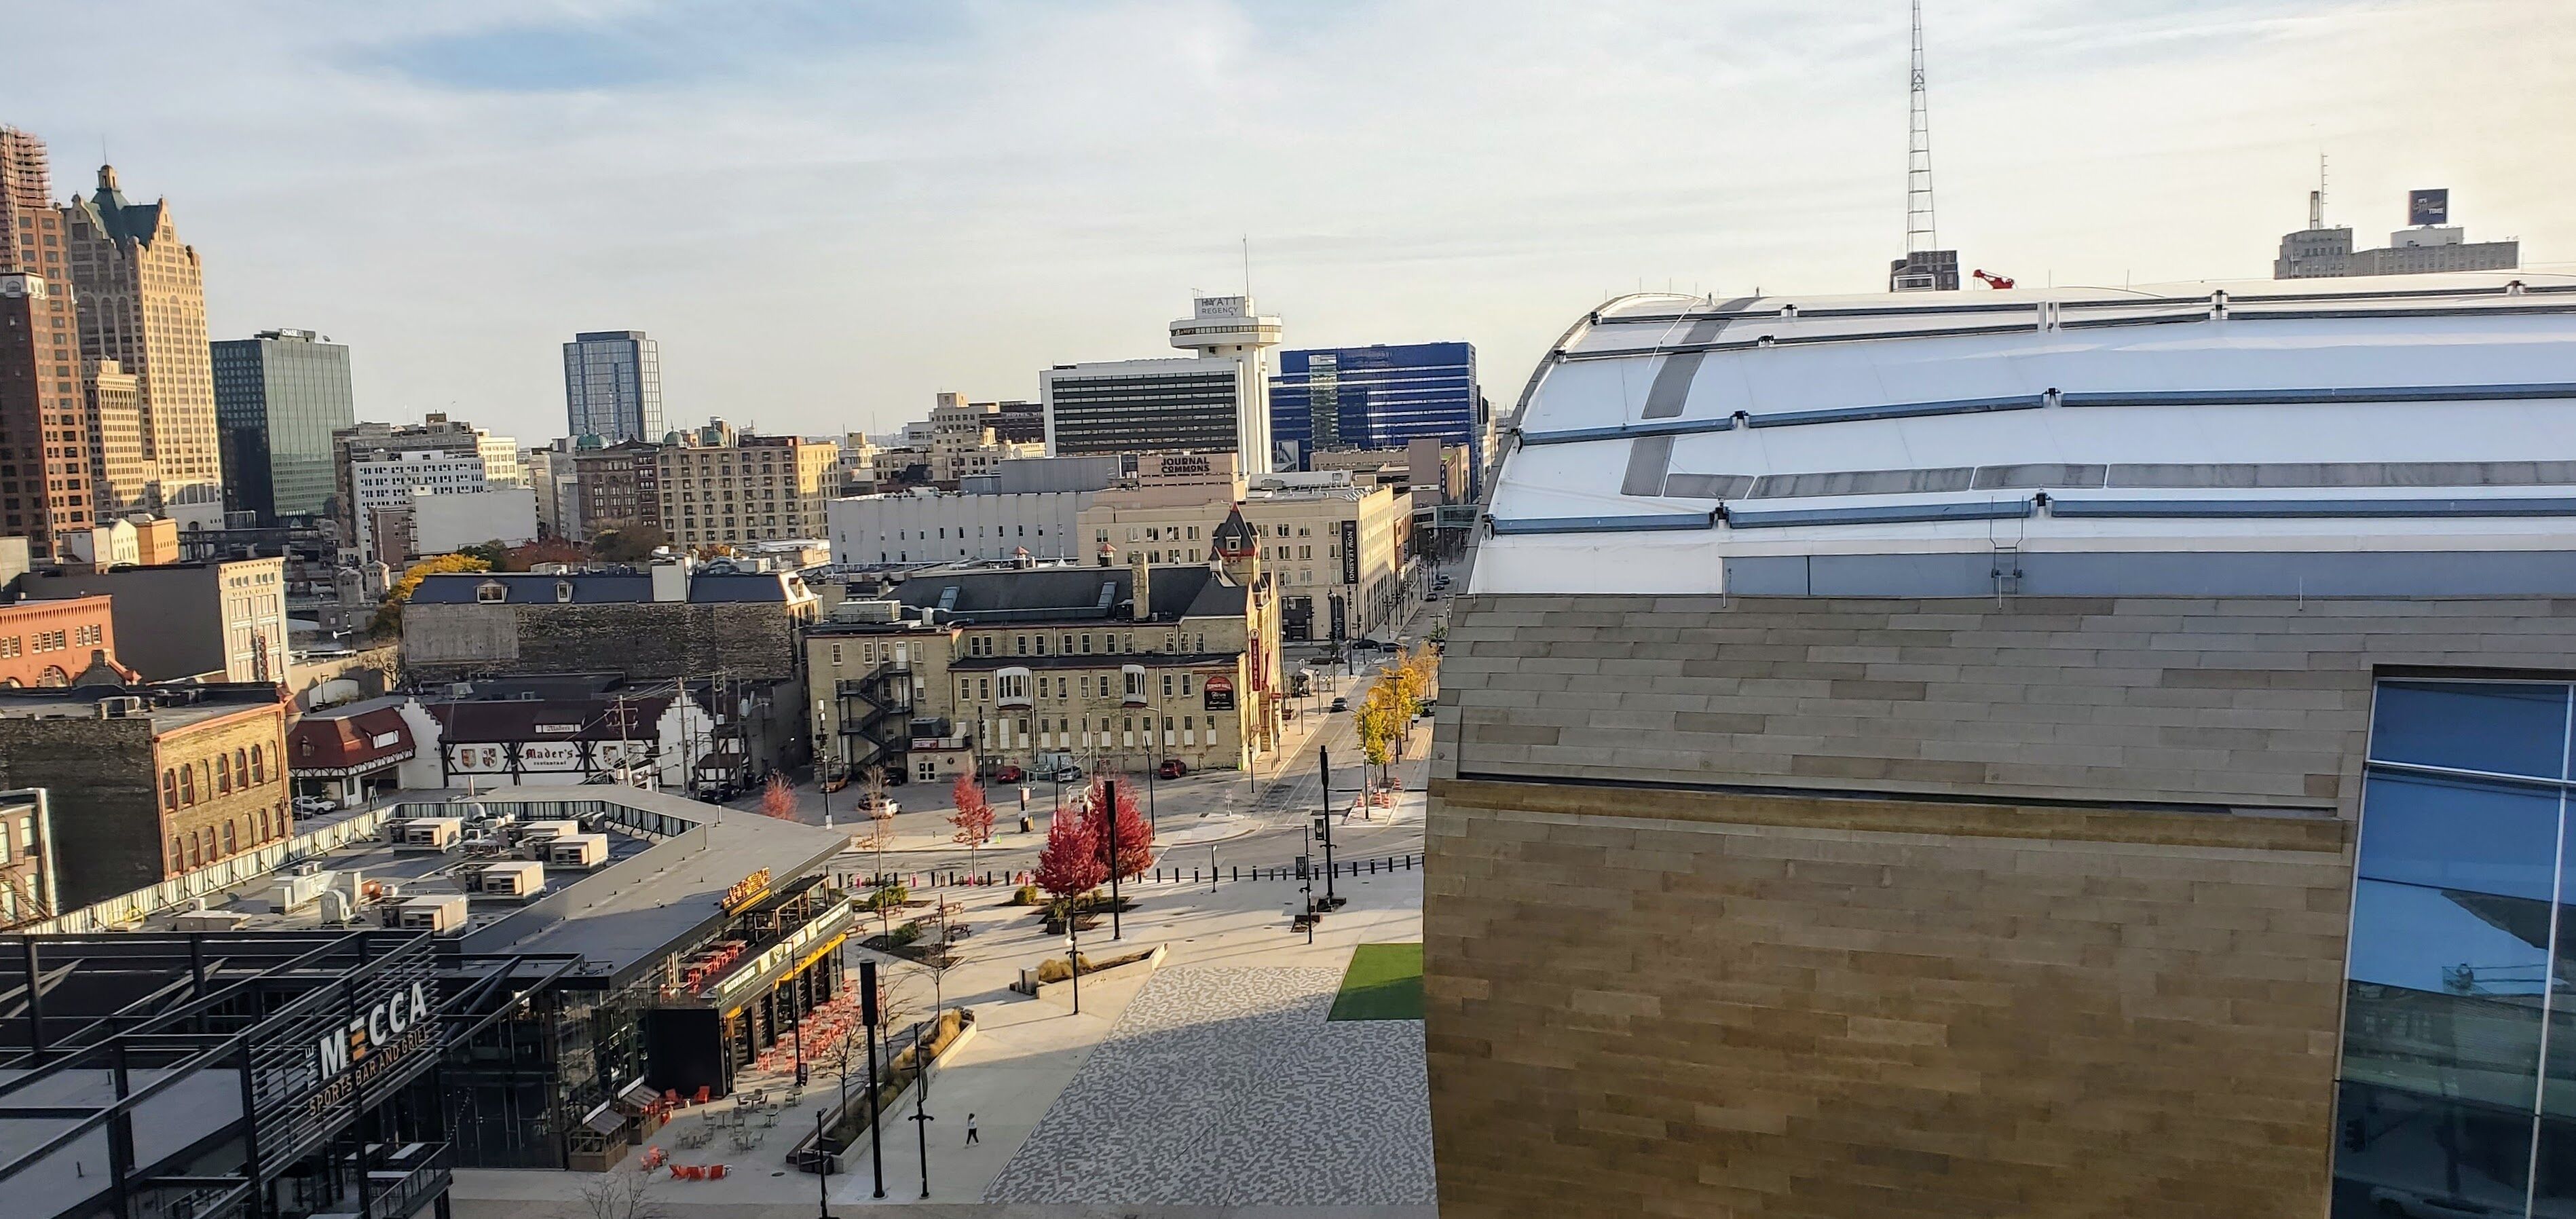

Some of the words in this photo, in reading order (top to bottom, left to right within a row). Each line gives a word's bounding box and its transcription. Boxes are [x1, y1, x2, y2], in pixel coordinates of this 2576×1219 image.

[1201, 298, 1237, 307] HYATT
[282, 329, 298, 337] CHASE
[1161, 457, 1210, 466] JOURNAL
[1161, 465, 1210, 473] COMMONS
[525, 747, 573, 759] Mader's
[320, 981, 427, 1081] MECCA
[305, 1045, 318, 1091] THE
[309, 1074, 352, 1117] SPORTS
[356, 1060, 377, 1087] BAR
[379, 1045, 400, 1071] AND
